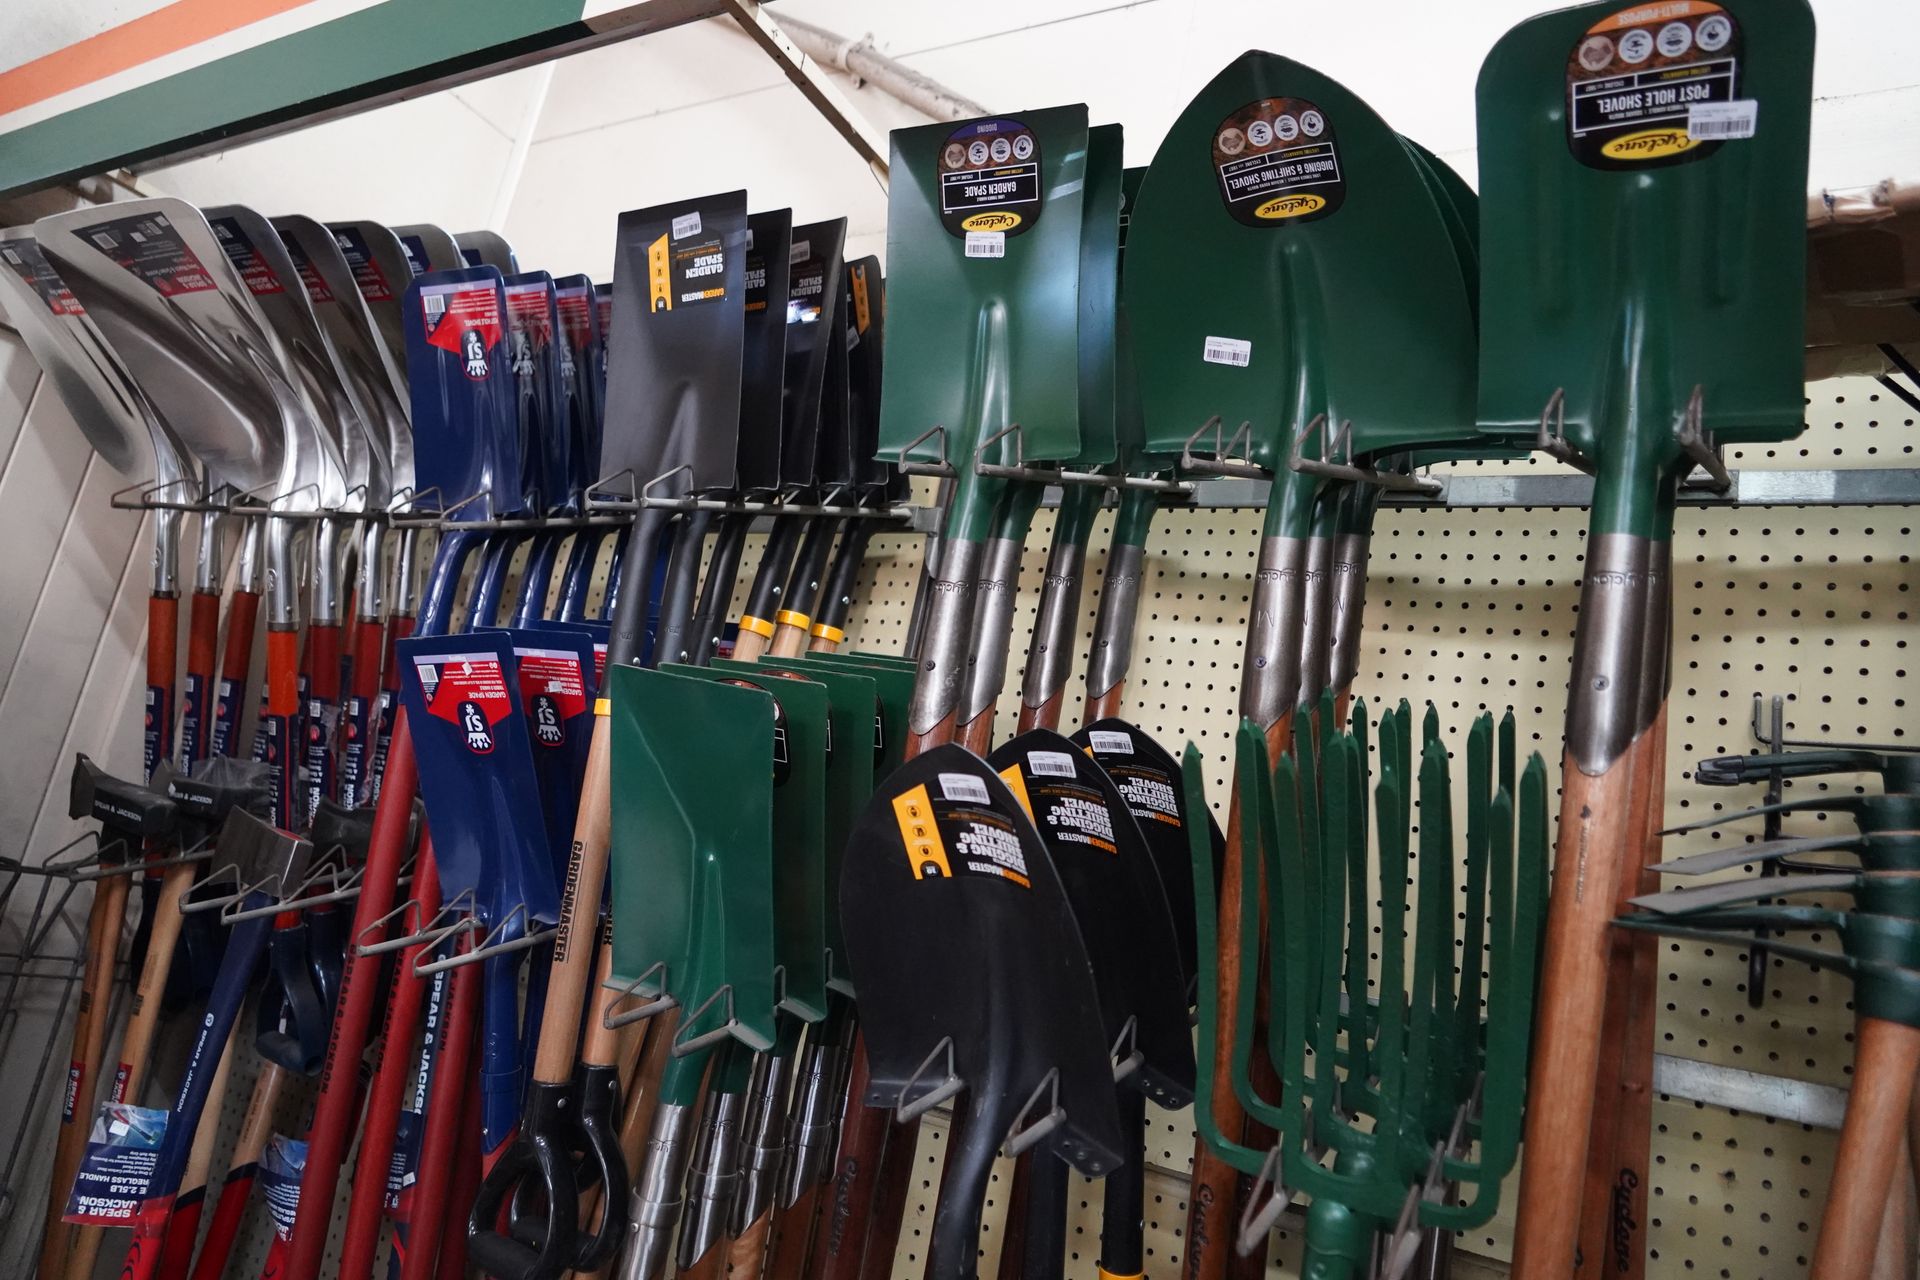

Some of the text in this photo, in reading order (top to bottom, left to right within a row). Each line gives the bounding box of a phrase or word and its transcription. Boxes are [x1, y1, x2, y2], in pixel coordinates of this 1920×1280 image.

[1618, 1, 1690, 26] MULTI-PURPOSE
[1597, 83, 1711, 114] POST HOLE SHOVEL
[1614, 134, 1691, 154] Cyclone
[1229, 160, 1334, 190] DIGGING & SHIFTING SHOVEL
[964, 181, 1017, 197] GARDEN SPADE
[1264, 197, 1318, 215] Cyclone
[968, 214, 1015, 229] Cyclone
[694, 253, 722, 268] SPADE
[686, 264, 724, 279] GARDEN
[798, 276, 822, 287] SPADE
[791, 285, 822, 297] GARDEN
[468, 342, 483, 360] SJ
[486, 691, 507, 699] GARDEN
[562, 688, 582, 696] GARDEN
[465, 714, 484, 732] SJ
[537, 707, 556, 724] SJ
[1118, 784, 1176, 804] SHIFTING
[1128, 776, 1174, 796] SHOVEL
[184, 792, 189, 800] &
[190, 794, 213, 804] JACKSON
[1060, 797, 1110, 818] SHOVEL
[1127, 794, 1178, 813] DIGGING
[110, 805, 116, 814] &
[116, 808, 142, 822] JACKSON
[1050, 806, 1112, 827] SHIFTING
[1130, 808, 1181, 828] GARDENMASTE
[969, 822, 1020, 848] SHOVEL
[1046, 814, 1114, 838] DIGGING &
[960, 832, 1024, 859] SHIFTING
[1056, 832, 1118, 854] GARDENMASTER
[956, 842, 1026, 868] DIGGING &
[554, 840, 584, 962] GARDENMASTER
[339, 956, 355, 1005] SPEAR
[438, 981, 456, 1051] JACKSON
[376, 1004, 394, 1073] JACKSON
[414, 970, 444, 1115] SPEAR & JACKS
[321, 1021, 342, 1094] JACKSON
[176, 1029, 208, 1113] SPEAR & JACKSON
[79, 1172, 150, 1186] REGLASS HANDLE
[110, 1184, 137, 1194] 2.5LB
[78, 1205, 132, 1218] SPEAR &
[79, 1195, 138, 1209] JACKSON
[1614, 1168, 1638, 1272] Cyclone
